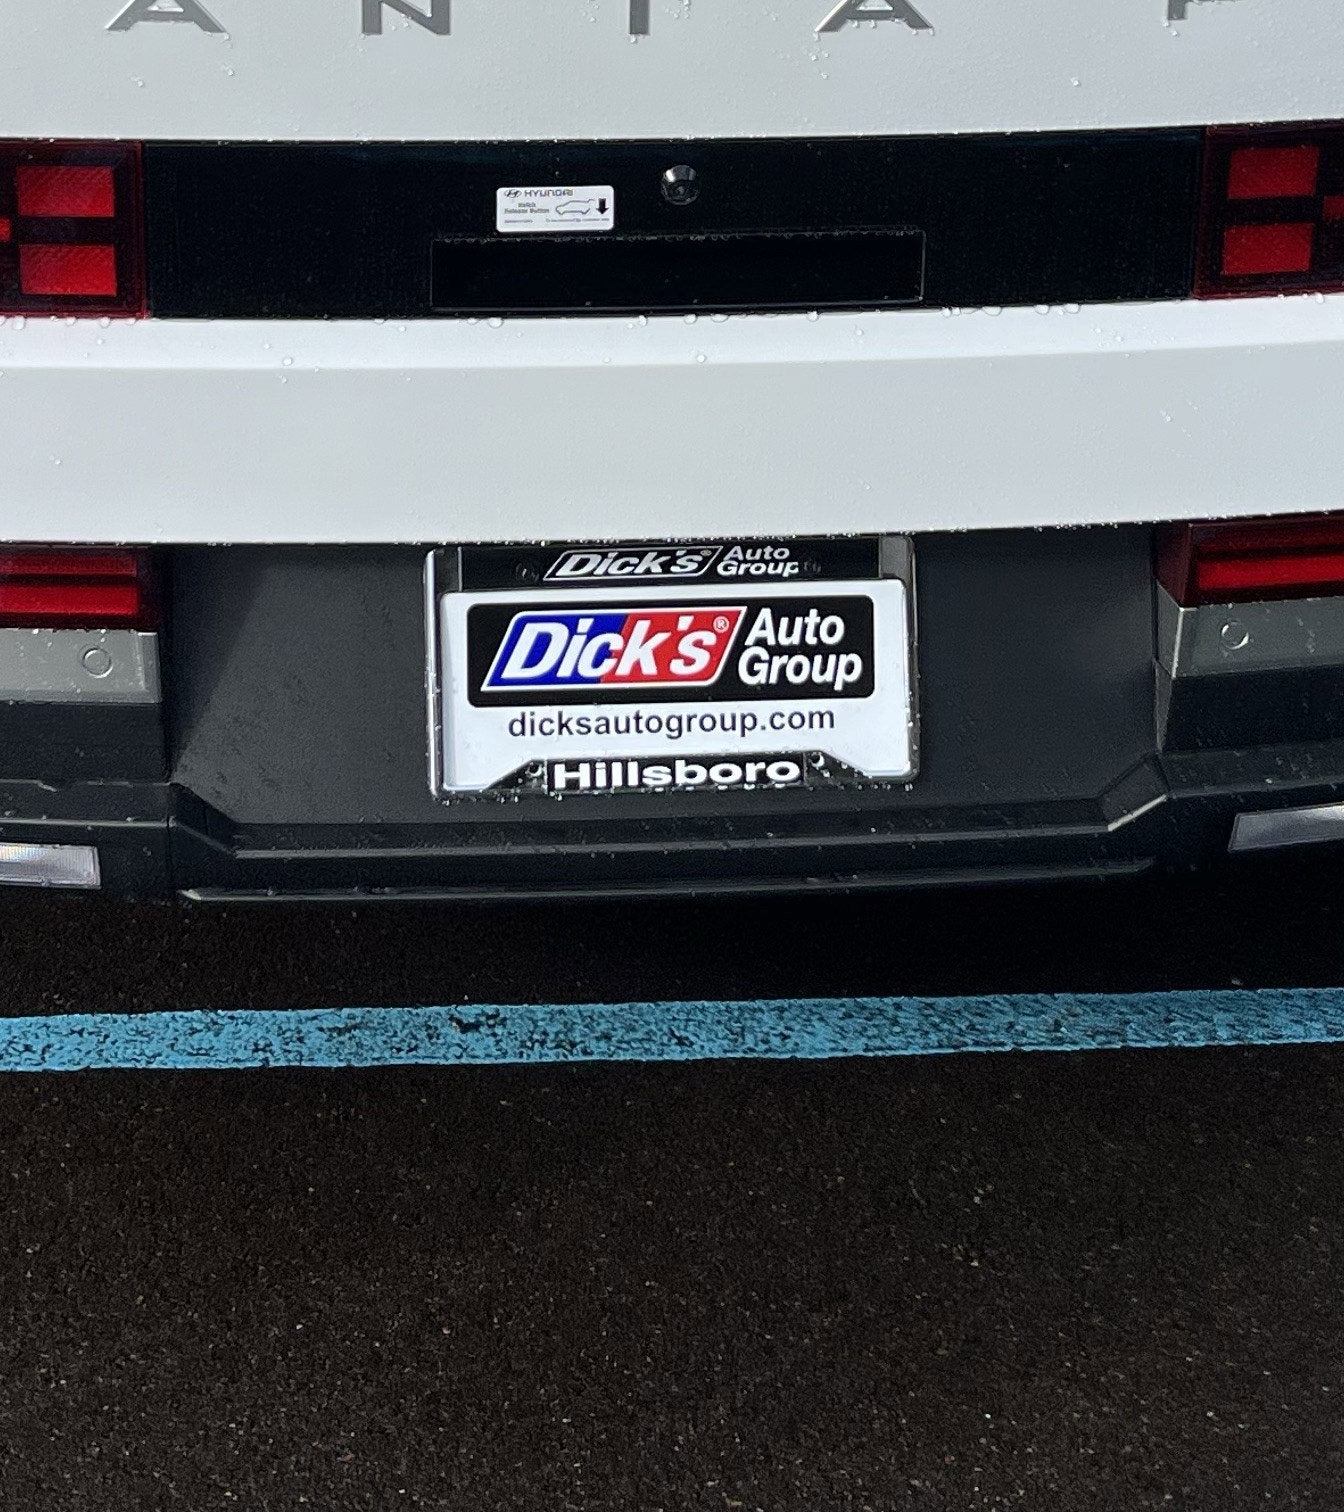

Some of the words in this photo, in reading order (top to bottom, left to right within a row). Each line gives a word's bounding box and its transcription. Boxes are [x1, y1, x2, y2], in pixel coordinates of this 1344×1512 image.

[717, 560, 800, 577] Group
[723, 546, 790, 561] Auto
[744, 607, 845, 646] Auto
[737, 645, 863, 691] Group
[508, 709, 835, 740] dicksautogroup.com
[553, 759, 801, 789] Hillsboro
